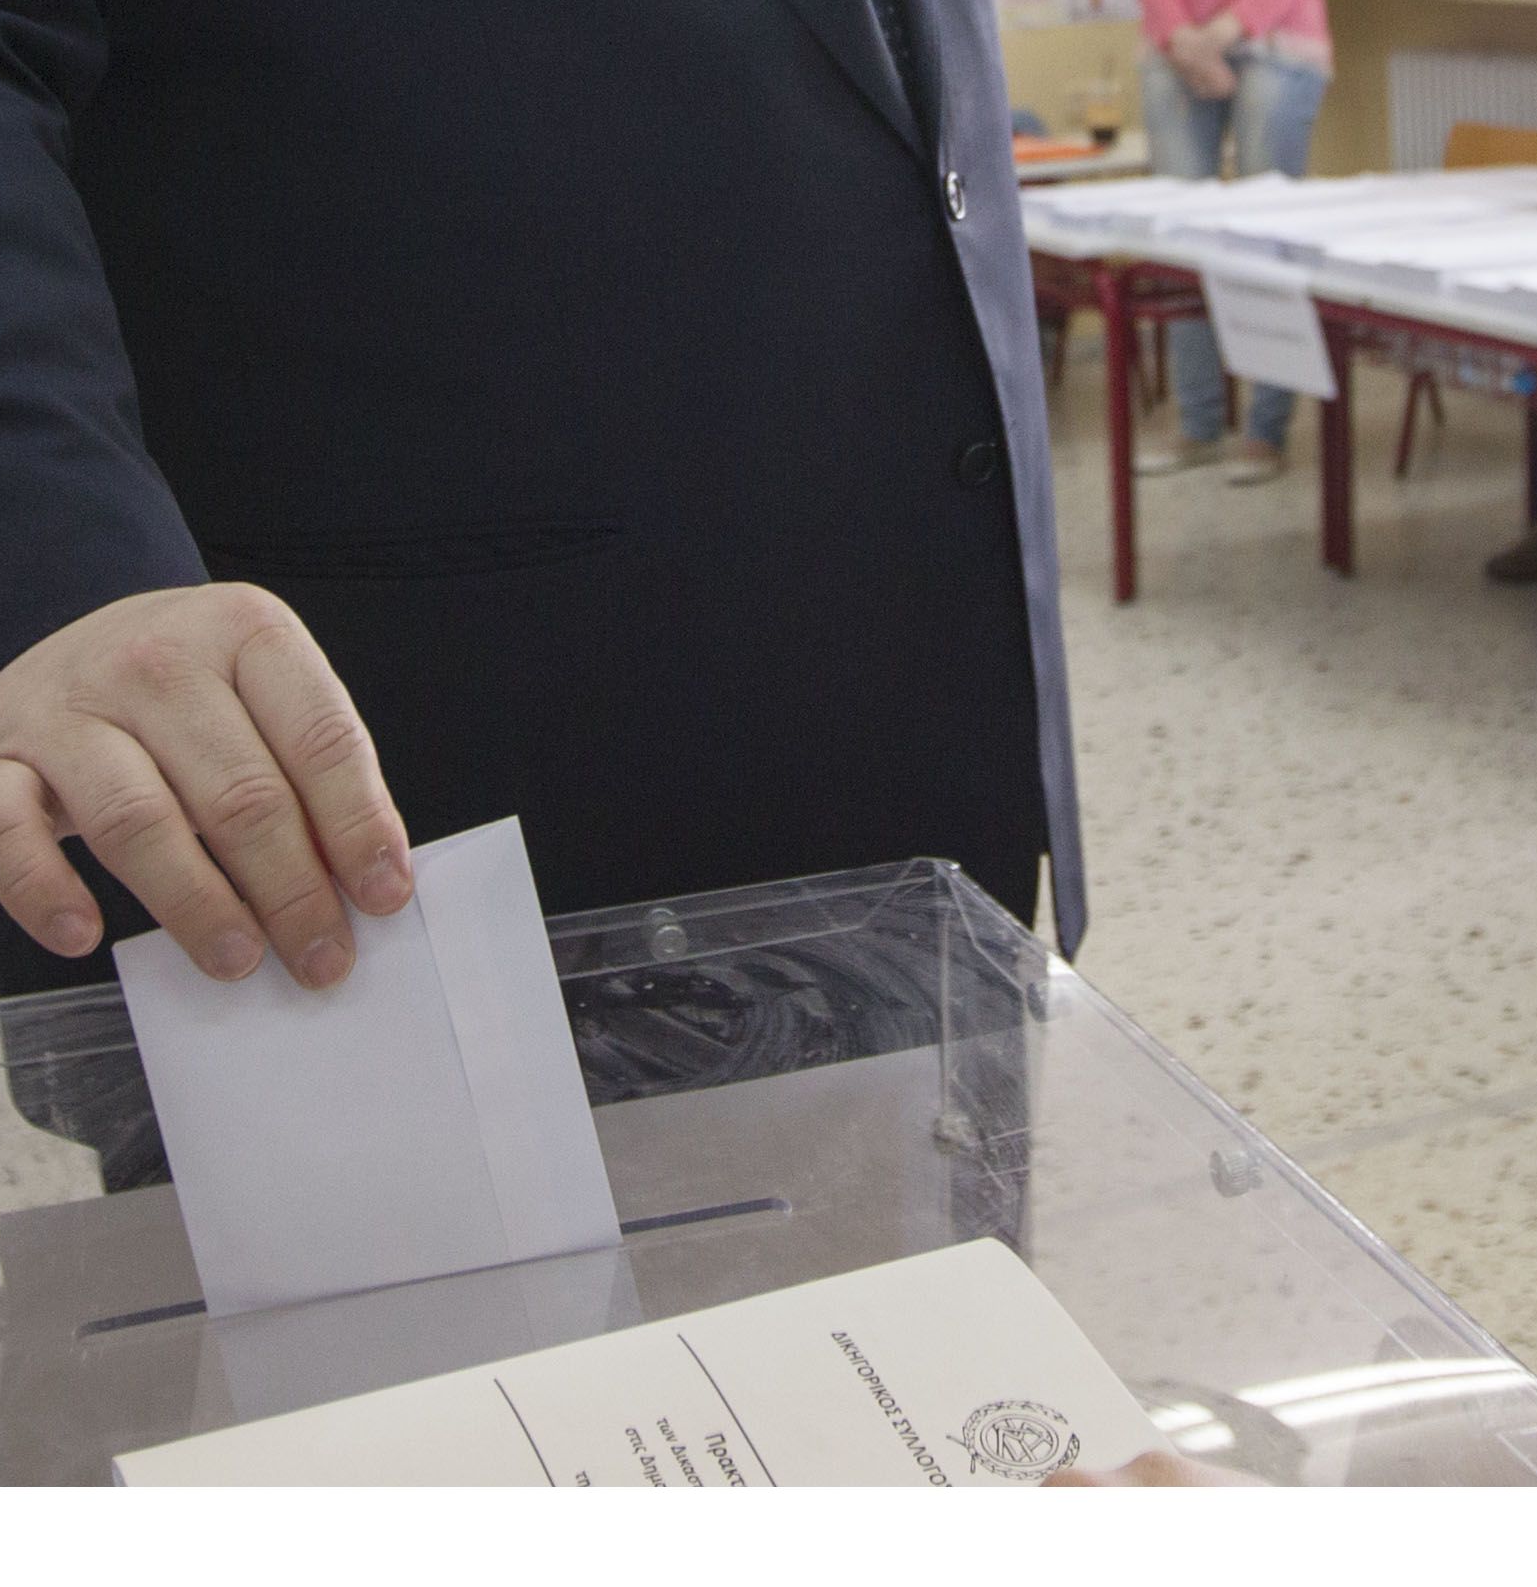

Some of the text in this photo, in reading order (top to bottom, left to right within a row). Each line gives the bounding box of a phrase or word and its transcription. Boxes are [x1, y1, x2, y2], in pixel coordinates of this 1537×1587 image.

[830, 1330, 954, 1487] ΔΙΚΗΓΟΡΙΚΟΣ ΣΥΛΛΟΓΟ
[624, 1426, 647, 1455] στις
[656, 1417, 678, 1443] των
